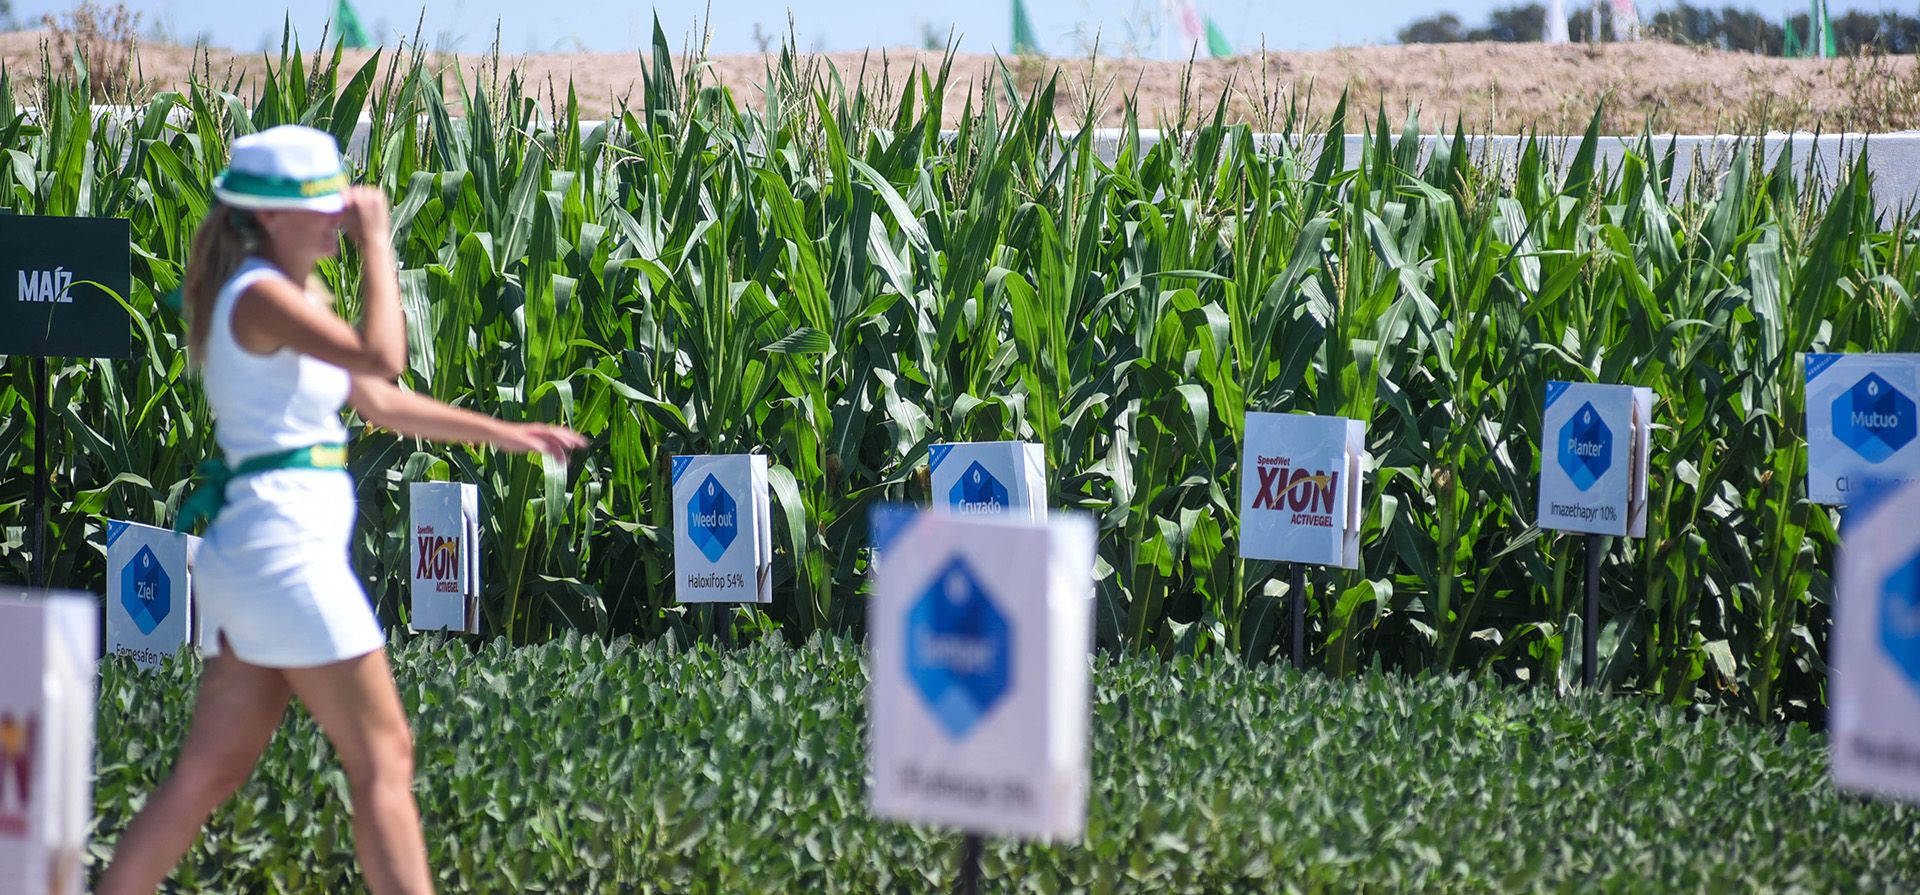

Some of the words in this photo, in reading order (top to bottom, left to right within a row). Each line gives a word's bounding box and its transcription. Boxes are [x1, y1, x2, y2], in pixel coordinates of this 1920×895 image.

[18, 266, 73, 303] MAÍZ
[1850, 411, 1898, 428] Mutuo
[1567, 438, 1603, 457] Planter
[1252, 466, 1339, 514] XION
[958, 496, 1001, 514] Cruzado
[1551, 501, 1598, 522] Imazethapyr
[1600, 506, 1617, 521] 10%
[692, 510, 716, 527] Weed
[718, 510, 733, 527] out
[1290, 513, 1334, 528] ACTIVEGEL
[416, 536, 460, 580] XION
[137, 581, 155, 601] Ziel
[687, 572, 725, 592] Haloxifop
[727, 573, 745, 589] 54%
